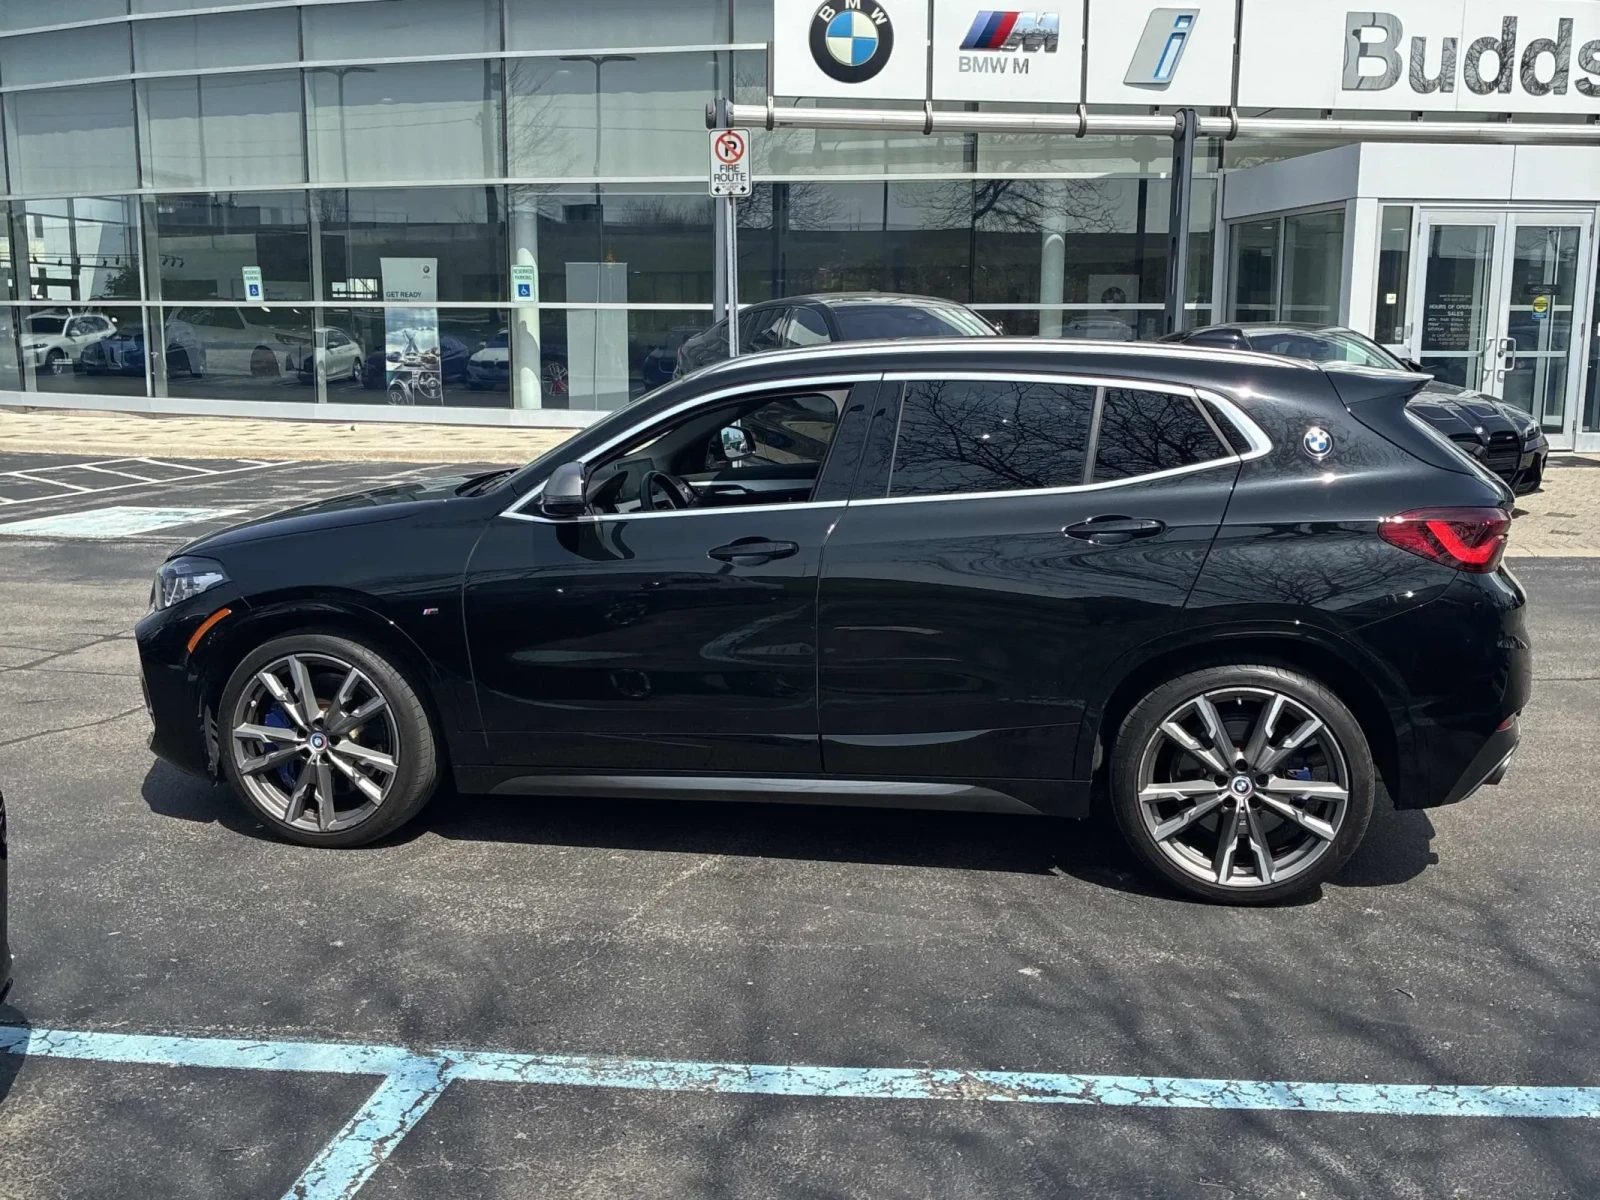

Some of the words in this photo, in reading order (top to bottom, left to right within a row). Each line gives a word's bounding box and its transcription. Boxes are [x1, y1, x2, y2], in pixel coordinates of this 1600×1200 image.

[818, 0, 888, 25] BMW
[1341, 11, 1600, 97] Budds
[958, 56, 1008, 74] BMW
[1012, 57, 1030, 75] M
[713, 173, 747, 182] ROUTE
[720, 164, 741, 173] FIRE
